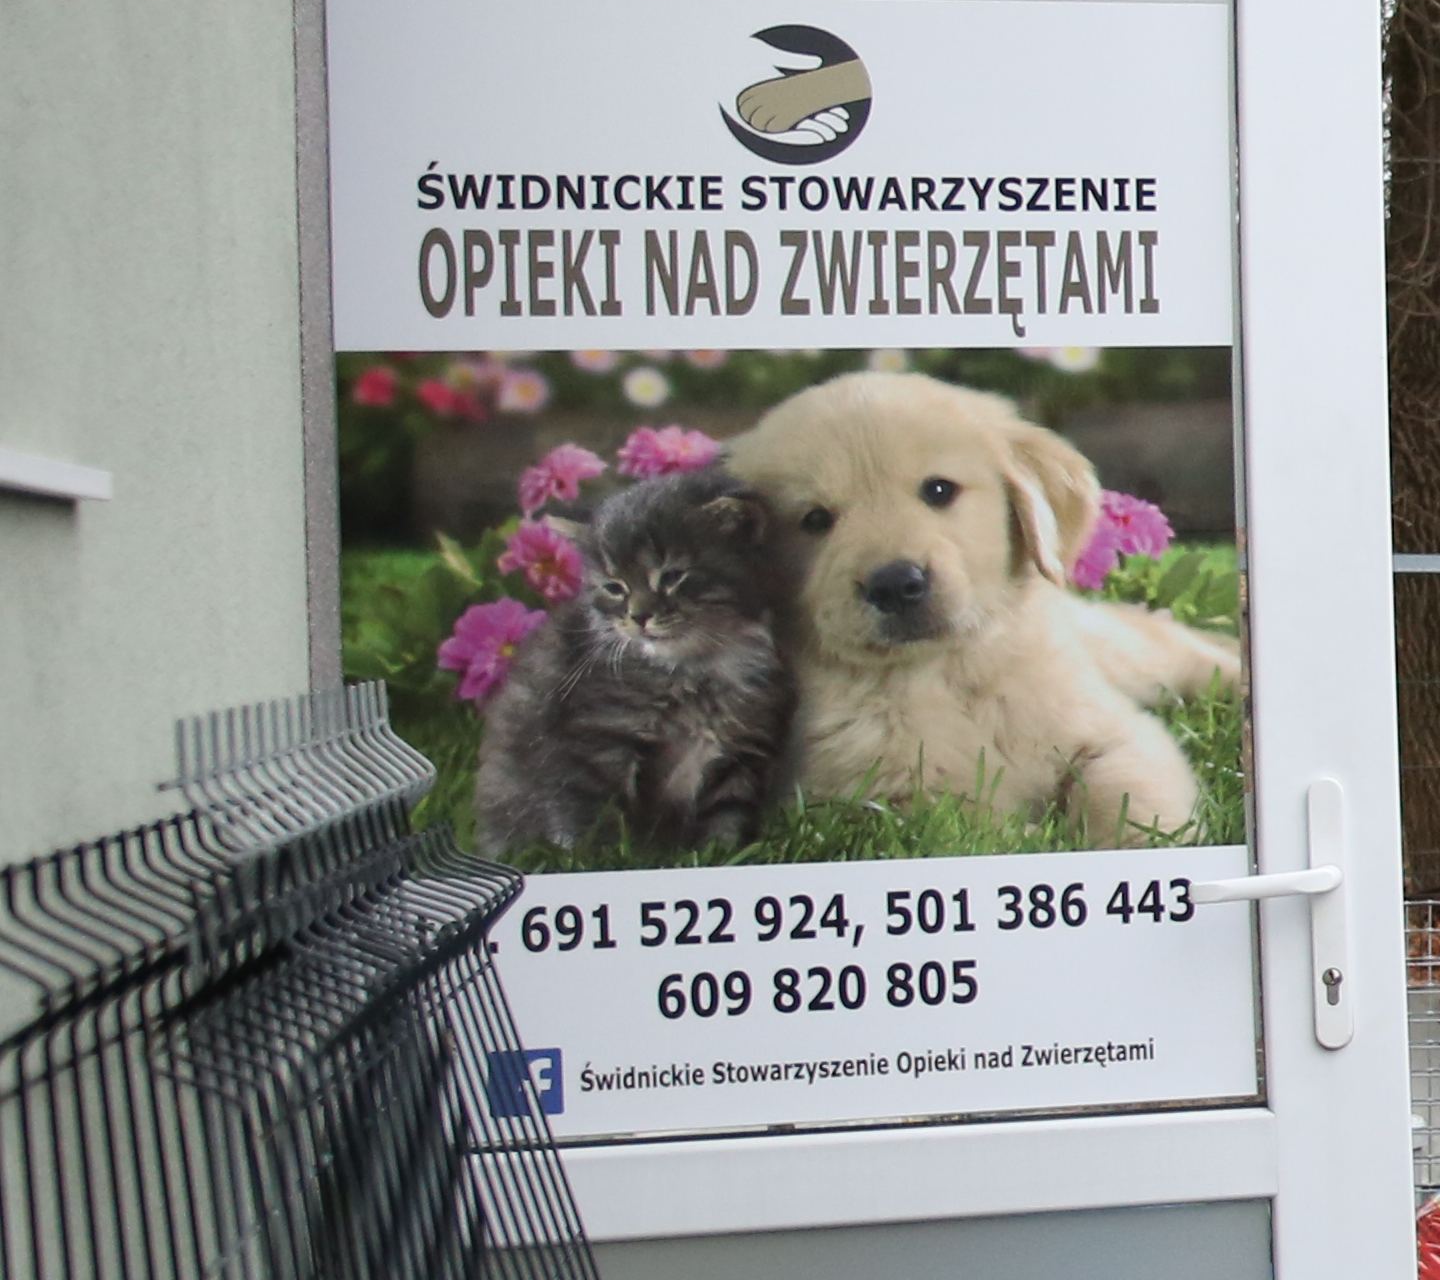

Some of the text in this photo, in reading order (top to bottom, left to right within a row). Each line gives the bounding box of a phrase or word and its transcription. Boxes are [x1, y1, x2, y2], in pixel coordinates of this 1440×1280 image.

[417, 160, 1157, 212] ŚWIDNICKIE STOWARZYSZENIE
[417, 227, 1160, 339] OPIEKI NAD ZWIERZĘTAMI
[521, 877, 1195, 953] 691 522 924, 501 386 443
[657, 959, 978, 1020] 609 820 805
[580, 1037, 1154, 1092] Świdnickie Stowarzyszenie Opieki nad Zwierzętami
